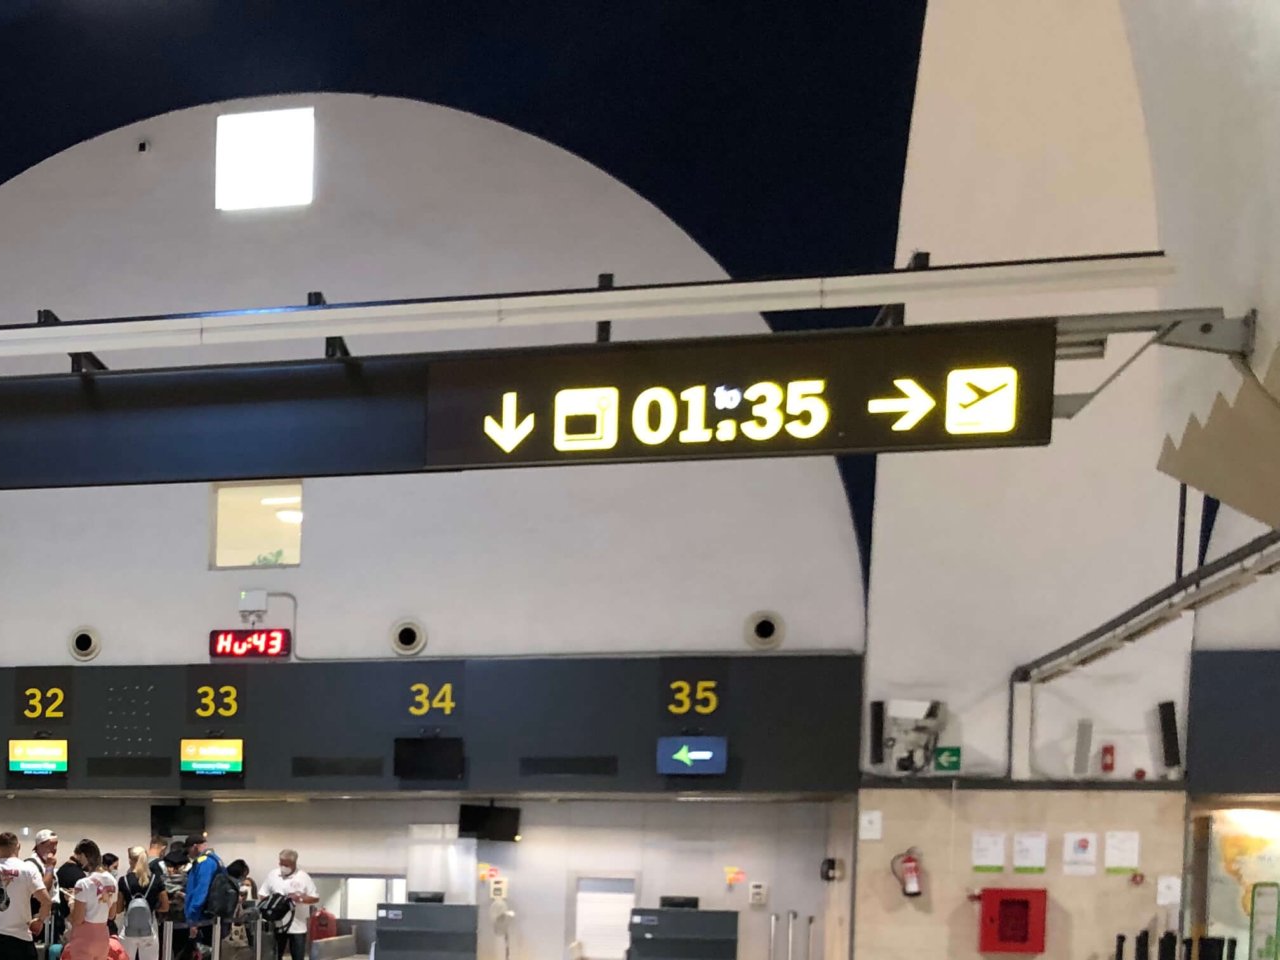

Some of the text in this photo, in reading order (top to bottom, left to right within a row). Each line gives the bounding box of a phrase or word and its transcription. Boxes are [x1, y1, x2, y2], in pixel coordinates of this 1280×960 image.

[631, 384, 713, 446] 01
[740, 378, 830, 442] 35
[23, 687, 65, 718] 32
[195, 686, 238, 717] 33
[409, 683, 455, 715] 34
[668, 680, 717, 714] 35
